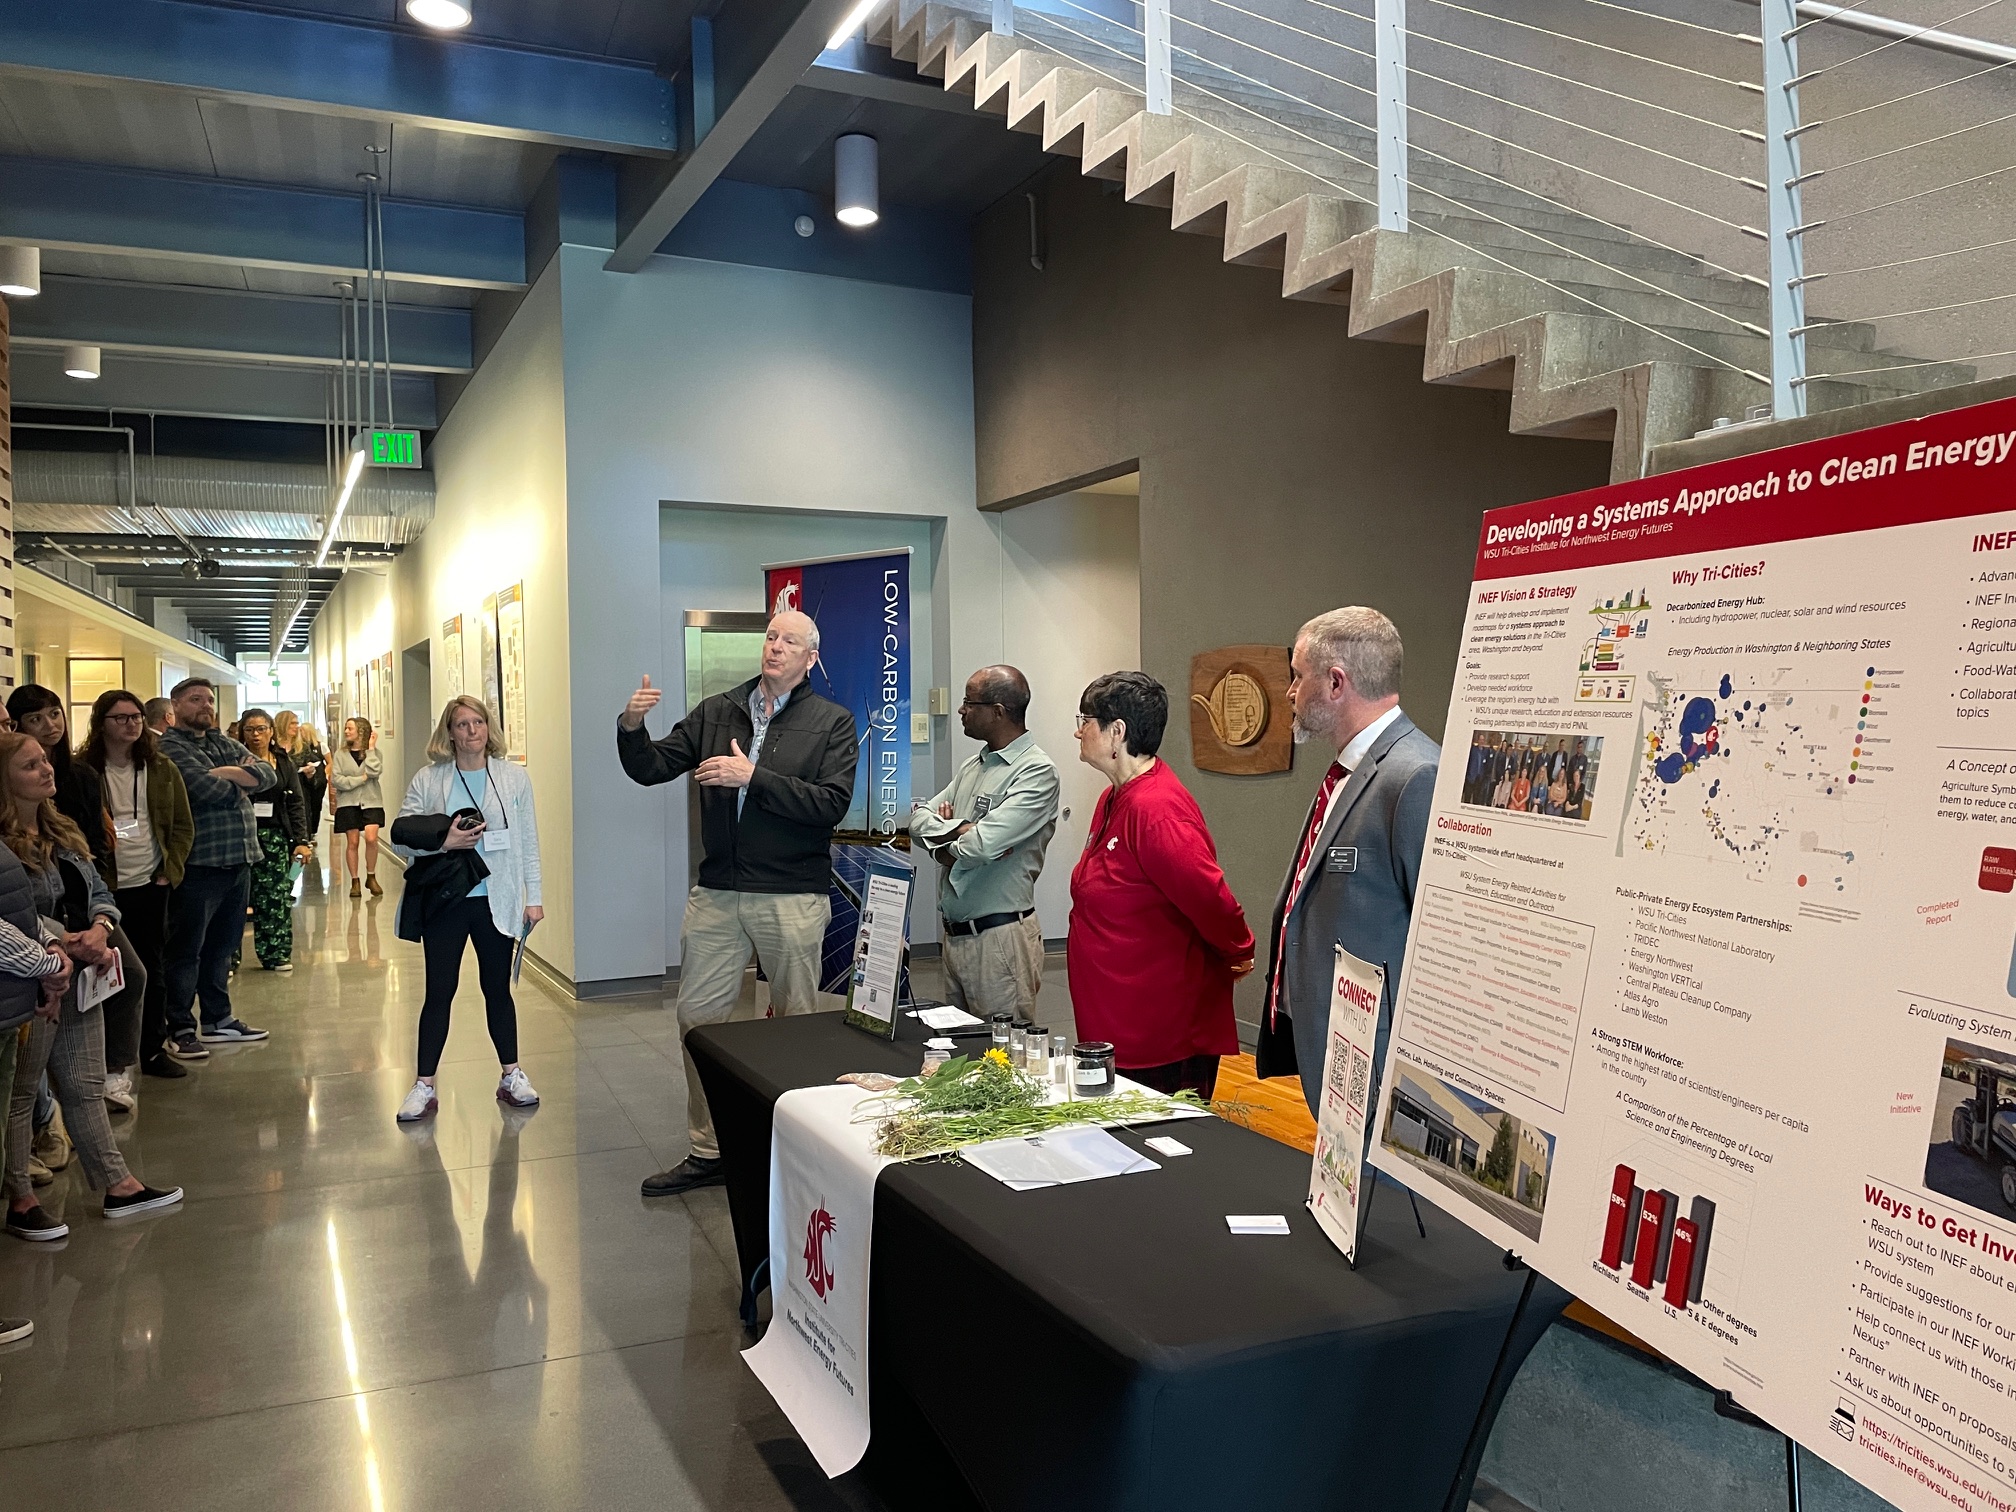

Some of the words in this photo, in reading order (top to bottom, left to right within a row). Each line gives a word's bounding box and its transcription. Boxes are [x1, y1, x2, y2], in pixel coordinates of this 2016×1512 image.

[373, 432, 414, 463] EXIT
[1487, 514, 1573, 544] Developing
[1577, 514, 1587, 528] a
[1592, 498, 1669, 529] Systems
[1673, 473, 1780, 515] Approach
[1788, 469, 1812, 492] to
[1820, 454, 1897, 485] Clean
[1906, 432, 2016, 470] Energy
[1484, 549, 1500, 559] WSU
[1502, 546, 1529, 556] Tri-Cities
[1530, 540, 1558, 552] Institute
[1559, 536, 1570, 548] for
[1571, 532, 1610, 546] Northwest
[1611, 529, 1640, 540] Energy
[1641, 523, 1673, 535] Futures
[1972, 531, 2016, 552] INEF
[1673, 570, 1698, 586] Why
[1703, 561, 1765, 581] Tri-Cities?
[1478, 592, 1499, 603] INEF
[1501, 590, 1526, 601] Vision
[1529, 588, 1535, 599] &
[1538, 586, 1577, 598] Strategy
[1667, 600, 1716, 611] Decarbonized
[1718, 599, 1744, 608] Energy
[1746, 596, 1765, 605] Hub:
[1679, 616, 1710, 625] Including
[1712, 613, 1758, 623] hydropower,
[1761, 610, 1791, 618] nuclear,
[1793, 607, 1814, 617] solar
[1816, 605, 1833, 615] and
[1836, 603, 1857, 613] wind
[1859, 602, 1906, 612] resources
[882, 569, 898, 743] LOW-CARBON
[1668, 648, 1693, 658] Energy
[1694, 646, 1734, 654] Production
[1735, 645, 1742, 653] in
[1745, 644, 1792, 654] Washington
[1794, 642, 1800, 651] &
[1802, 640, 1858, 653] Neighboring
[1860, 639, 1891, 649] States
[1957, 706, 1989, 719] topics
[881, 751, 897, 852] ENERGY
[1438, 817, 1492, 836] Collaboration
[1984, 856, 1999, 864] RAW
[1616, 887, 1662, 904] Public-Private
[1665, 897, 1690, 912] Energy
[1692, 903, 1734, 919] Ecosystem
[1736, 912, 1792, 932] Partnerships:
[1638, 906, 1655, 917] WSU
[1657, 910, 1686, 924] Tri-Cities
[1917, 900, 1959, 914] Completed
[1926, 914, 1951, 925] Report
[1634, 933, 1659, 948] TRIDEC
[1636, 919, 1657, 933] Pacific
[1659, 925, 1696, 942] Northwest
[1698, 935, 1729, 950] National
[1731, 942, 1775, 962] Laboratory
[1631, 947, 1655, 963] Energy
[1656, 954, 1693, 972] Northwest
[1629, 962, 1668, 980] Washington
[1671, 973, 1703, 990] VERTical
[1338, 976, 1376, 1015] CONNECT
[1623, 990, 1640, 1002] Atlas
[1642, 995, 1659, 1007] Agro
[1626, 975, 1651, 990] Central
[1652, 983, 1678, 998] Plateau
[1680, 992, 1711, 1009] Cleanup
[1714, 1001, 1752, 1022] Company
[1344, 1005, 1358, 1028] WITH
[1358, 1015, 1367, 1034] US
[1621, 1003, 1640, 1016] Lamb
[1642, 1010, 1667, 1025] Weston
[1908, 1004, 1966, 1030] Evaluating
[1969, 1019, 2012, 1039] System
[1592, 1028, 1597, 1036] A
[1598, 1030, 1620, 1046] Strong
[1622, 1039, 1642, 1053] STEM
[1645, 1046, 1683, 1068] Workforce:
[1397, 1047, 1411, 1059] Office,
[1412, 1054, 1422, 1065] Lab,
[1423, 1060, 1443, 1076] Hoteling
[1445, 1071, 1454, 1079] and
[1455, 1074, 1484, 1094] Community
[1485, 1088, 1505, 1104] Spaces:
[1609, 1064, 1620, 1074] the
[1621, 1070, 1647, 1086] country
[1890, 1105, 1921, 1114] Initiative
[1896, 1092, 1913, 1100] New
[1616, 1091, 1621, 1099] A
[1624, 1094, 1666, 1117] Comparison
[1667, 1114, 1676, 1122] of
[1676, 1116, 1689, 1128] the
[1690, 1122, 1736, 1148] Percentage
[1738, 1144, 1748, 1152] of
[1749, 1146, 1773, 1163] Local
[1626, 1110, 1653, 1128] Science
[1655, 1124, 1670, 1135] and
[1671, 1129, 1717, 1158] Engineering
[1719, 1150, 1754, 1173] Degrees
[1611, 1194, 1626, 1208] 58%
[1866, 1184, 1911, 1219] Ways
[1918, 1208, 1936, 1229] to
[1942, 1218, 1977, 1247] Get
[1643, 1210, 1658, 1225] 52%
[1676, 1228, 1691, 1243] 46%
[1869, 1236, 1893, 1256] WSU
[1896, 1252, 1934, 1275] system
[1871, 1218, 1902, 1242] Reach
[1906, 1237, 1923, 1251] out
[1926, 1244, 1937, 1256] to
[1940, 1249, 1967, 1268] INEF
[1970, 1265, 2003, 1287] about
[1593, 1261, 1619, 1283] Richland
[1627, 1282, 1649, 1302] Seattle
[1864, 1260, 1903, 1287] Provide
[1906, 1283, 1972, 1321] suggestions
[1976, 1313, 1992, 1329] for
[1995, 1326, 2016, 1341] our
[1664, 1305, 1677, 1320] U.S.
[1687, 1307, 1693, 1317] S
[1694, 1312, 1699, 1322] &
[1702, 1316, 1707, 1326] E
[1708, 1322, 1738, 1345] degrees
[1703, 1299, 1724, 1317] Other
[1726, 1314, 1757, 1337] degrees
[1860, 1283, 1914, 1319] Participate
[1918, 1312, 1927, 1326] in
[1930, 1321, 1949, 1336] our
[1952, 1329, 1979, 1349] INEF
[805, 1312, 826, 1345] Institute
[787, 1309, 812, 1347] Northwest
[813, 1339, 832, 1371] Energy
[833, 1361, 854, 1397] Futures
[1856, 1307, 1880, 1328] Help
[1883, 1324, 1925, 1352] connect
[1928, 1347, 1941, 1360] us
[1945, 1355, 1967, 1373] with
[1971, 1367, 2003, 1389] those
[1849, 1348, 1886, 1375] Partner
[1889, 1372, 1910, 1390] with
[1913, 1383, 1939, 1404] INEF
[1942, 1402, 1956, 1416] on
[1959, 1412, 2016, 1451] proposals
[1859, 1435, 1972, 1512] tricities.inef@wsu.edu
